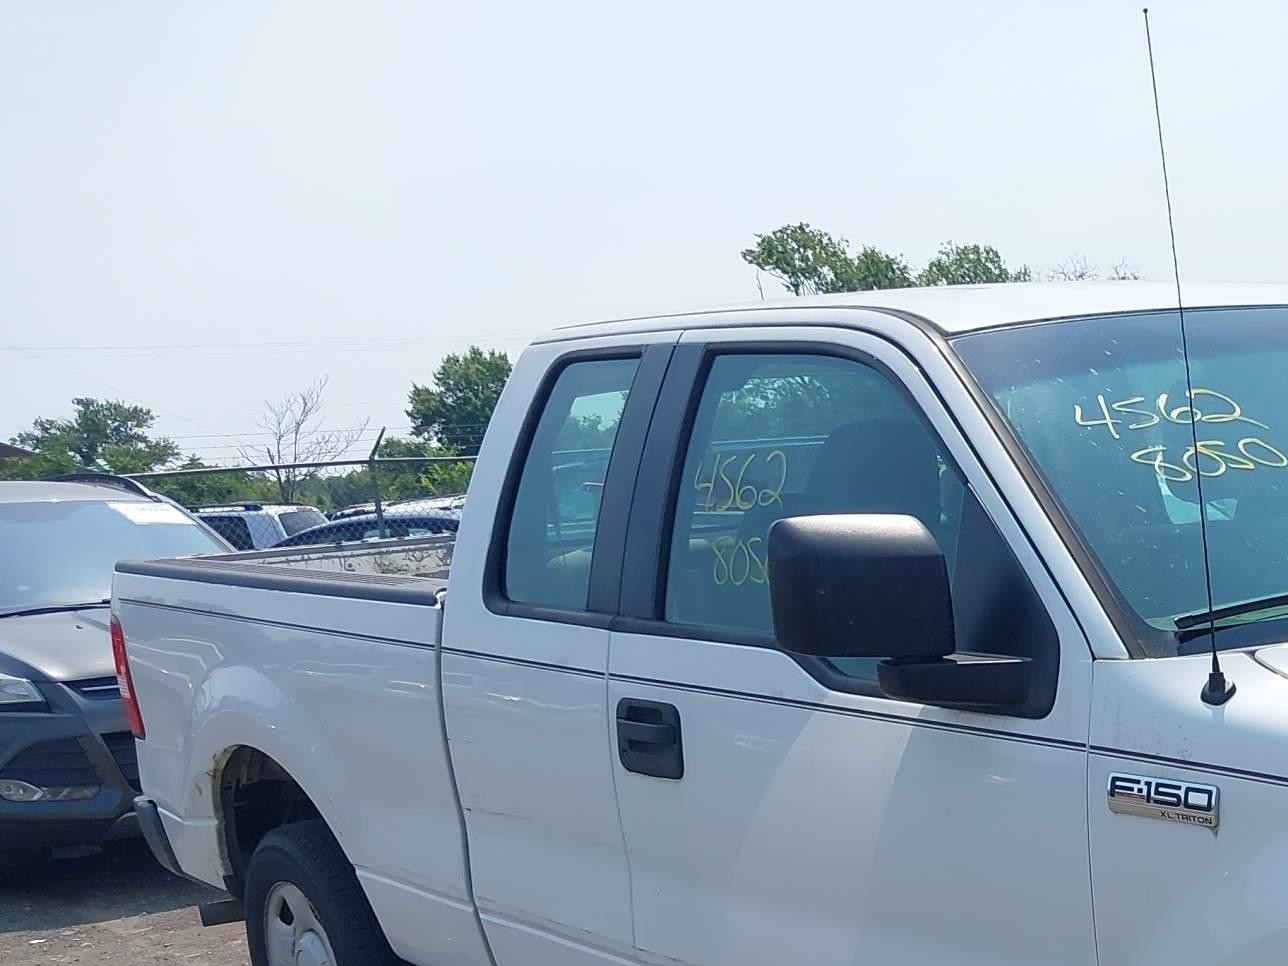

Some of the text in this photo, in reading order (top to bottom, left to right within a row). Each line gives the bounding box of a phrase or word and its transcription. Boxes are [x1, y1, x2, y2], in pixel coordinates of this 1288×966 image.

[1074, 388, 1269, 440] 4562
[694, 450, 786, 512] 4562
[1130, 438, 1288, 482] 8050
[711, 536, 769, 585] 805
[1160, 810, 1213, 825] XL TRITON
